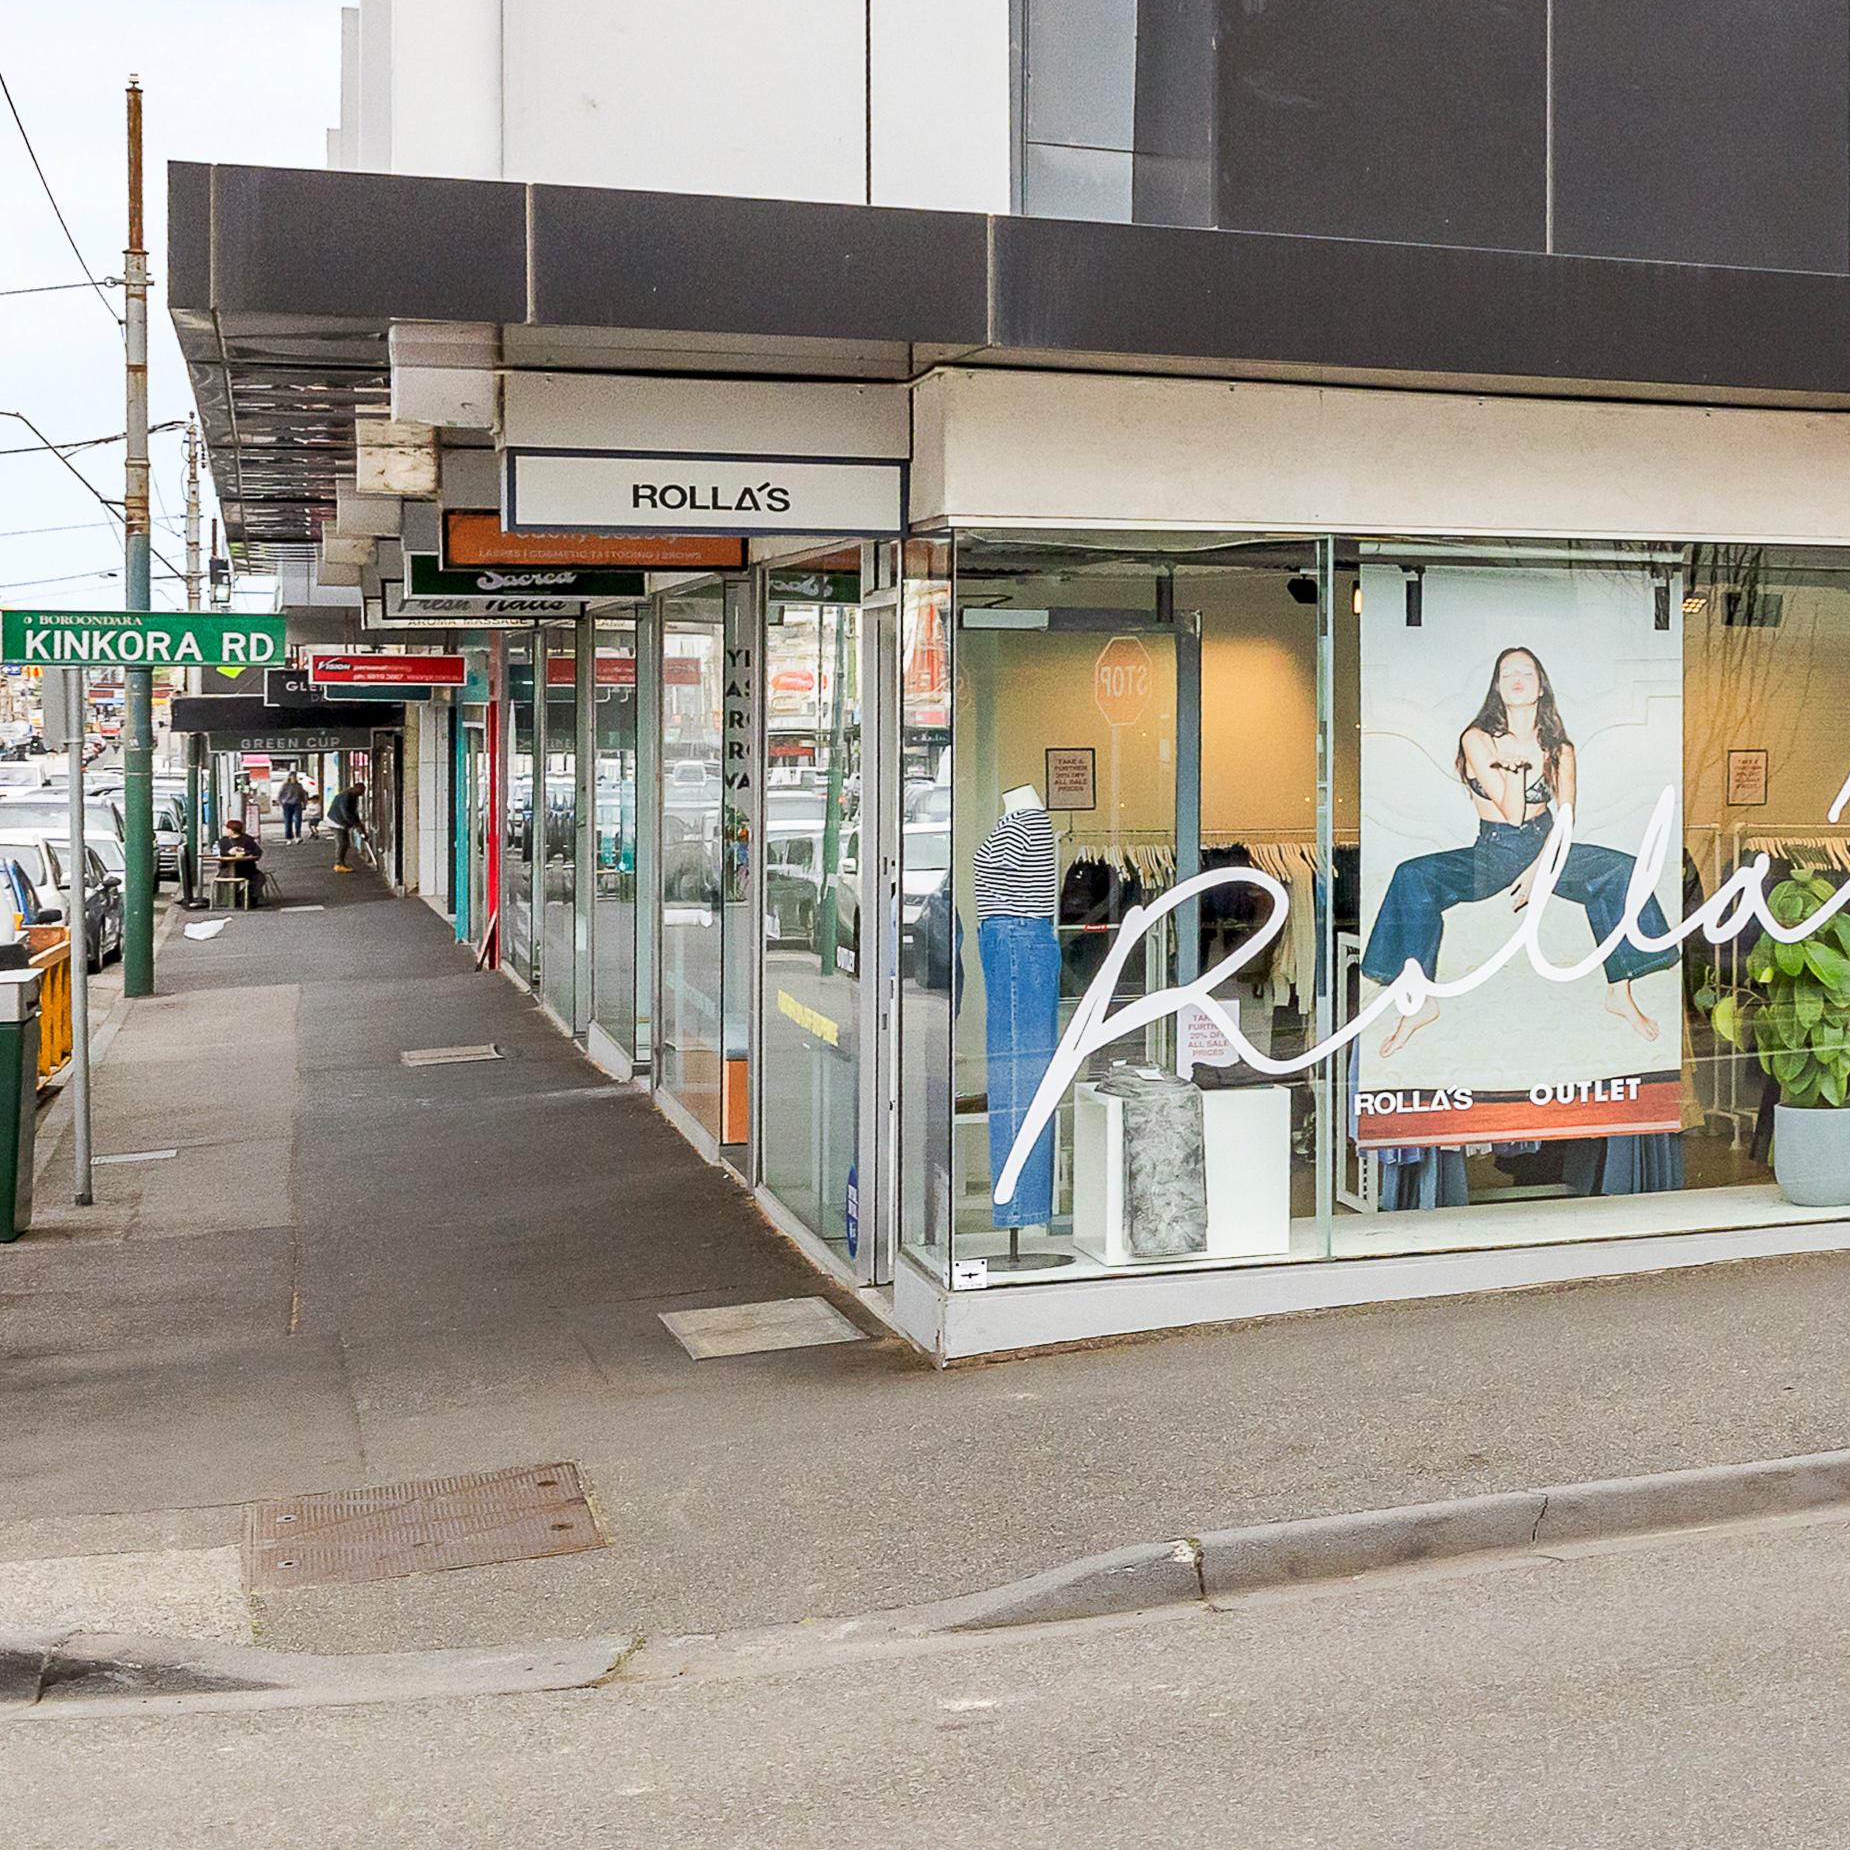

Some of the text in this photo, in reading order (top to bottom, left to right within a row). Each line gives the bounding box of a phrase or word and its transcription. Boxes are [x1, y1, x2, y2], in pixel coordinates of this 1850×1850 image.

[39, 615, 143, 626] BOROONDARA
[25, 630, 275, 662] KINKORA RD
[241, 737, 341, 749] GREEN CUP
[1354, 1078, 1642, 1116] ROLLA'S OUTLET
